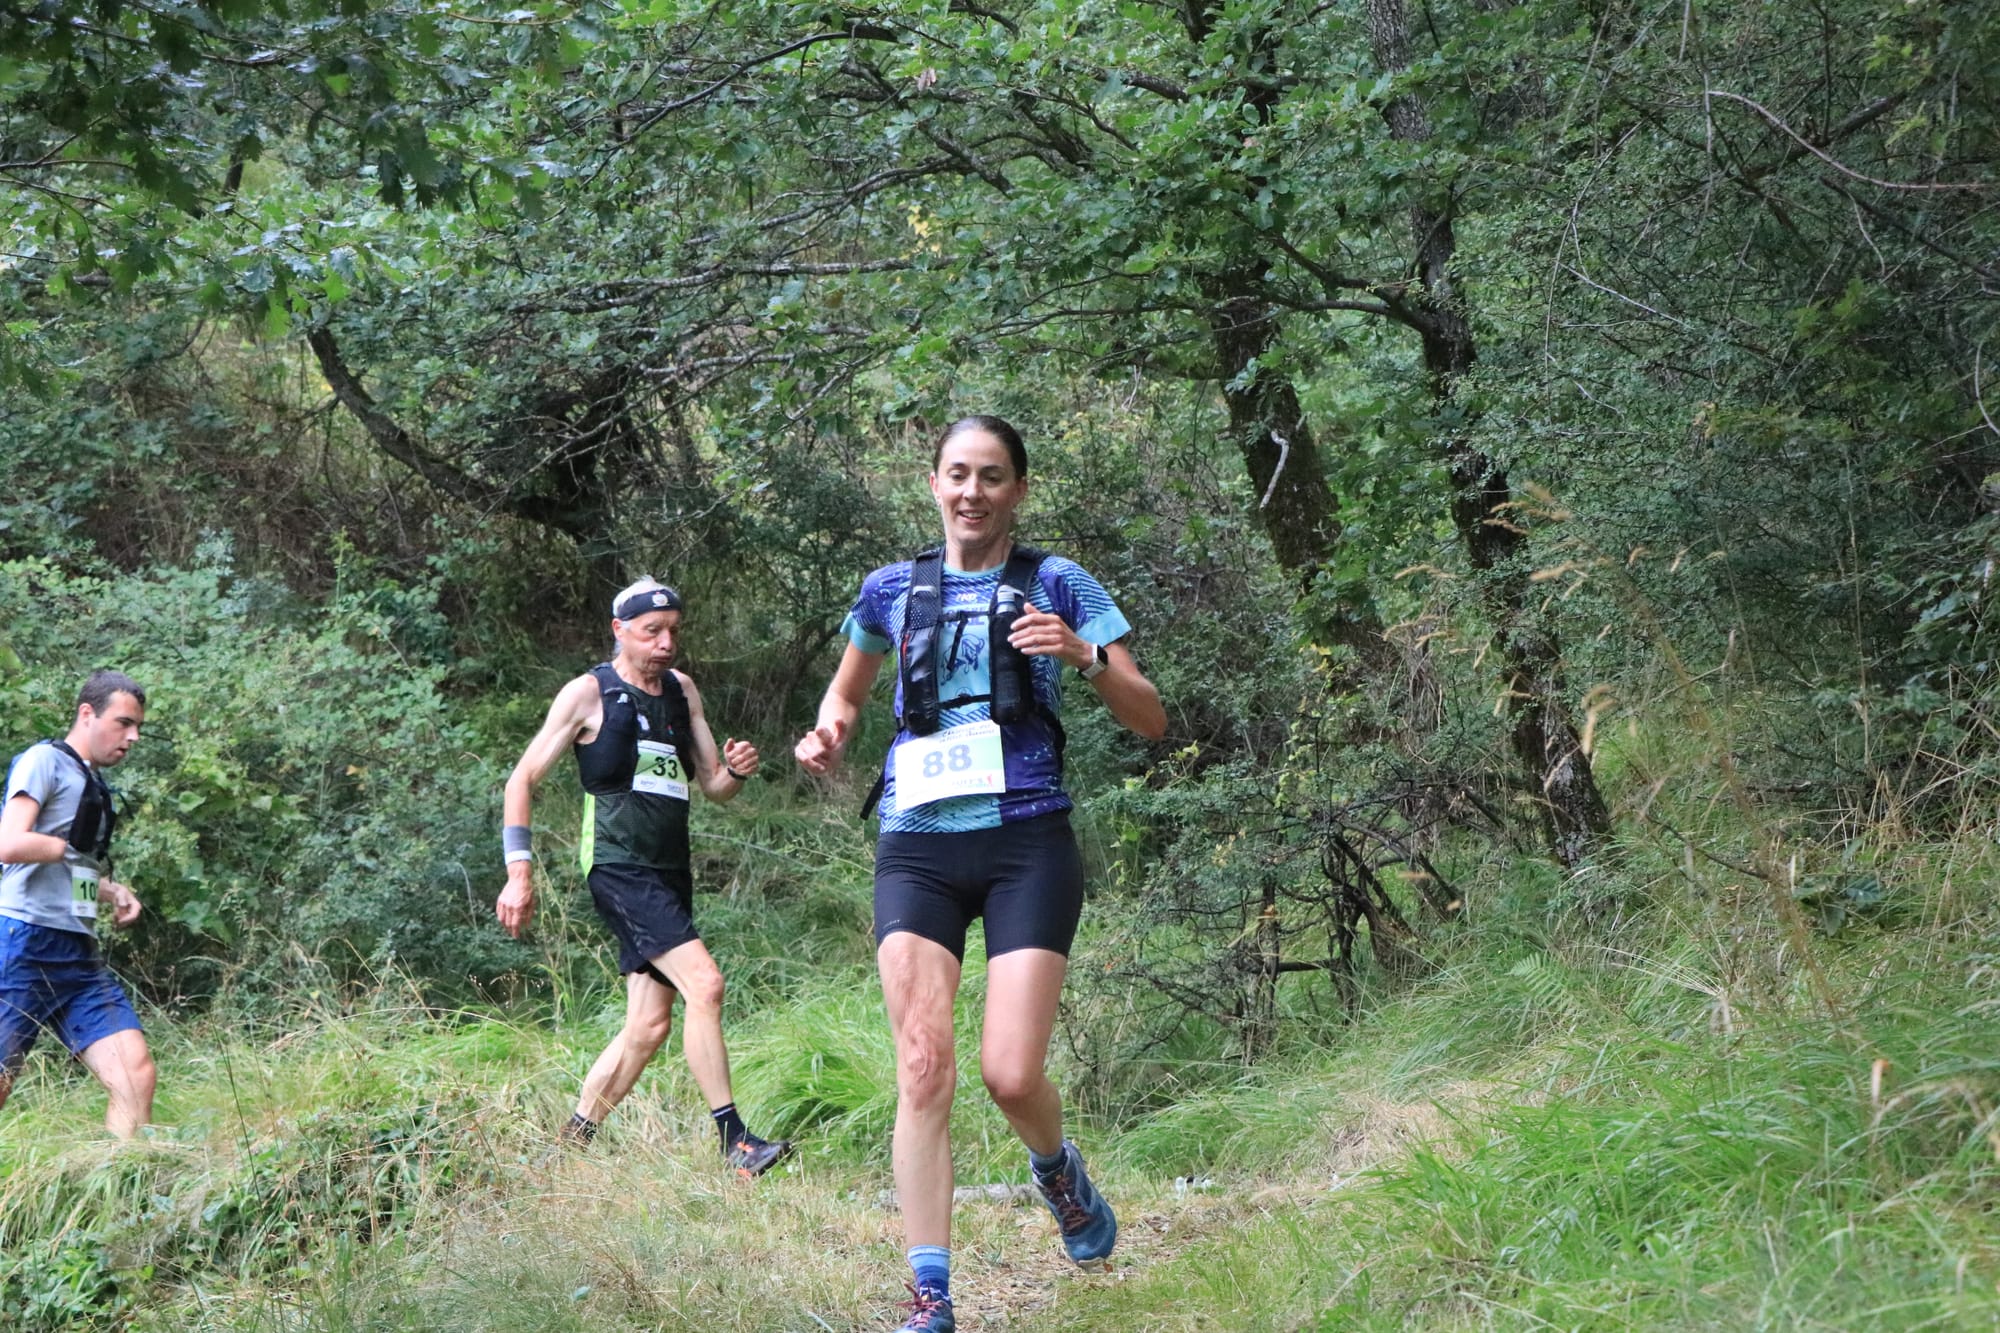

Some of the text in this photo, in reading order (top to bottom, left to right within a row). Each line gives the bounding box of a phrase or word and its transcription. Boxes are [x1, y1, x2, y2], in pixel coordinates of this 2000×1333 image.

[652, 756, 678, 779] 33
[922, 744, 972, 778] 88
[80, 880, 98, 901] 10
